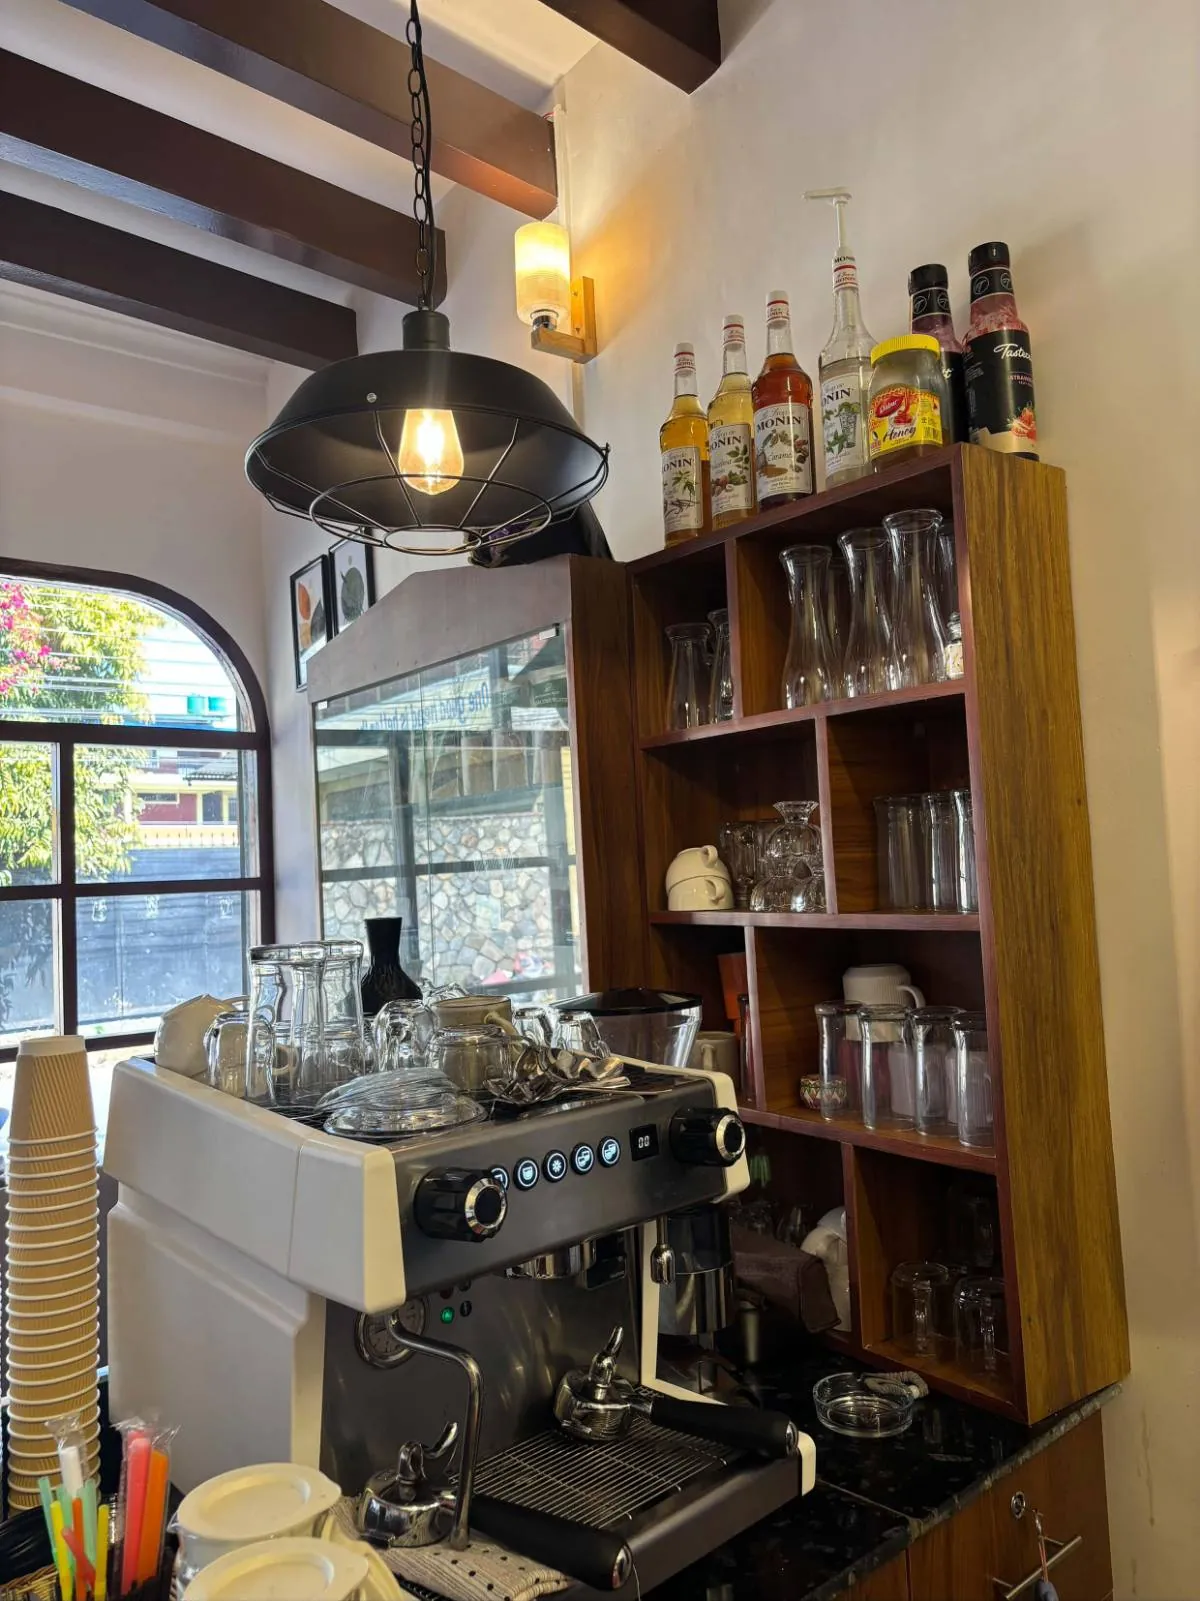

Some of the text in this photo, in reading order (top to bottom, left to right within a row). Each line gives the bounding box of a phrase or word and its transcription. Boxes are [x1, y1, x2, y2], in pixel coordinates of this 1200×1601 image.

[756, 416, 801, 433] MONIN
[883, 427, 917, 442] Honey
[710, 436, 742, 450] ONIN
[662, 457, 692, 472] ONIN
[638, 1135, 651, 1149] 00
